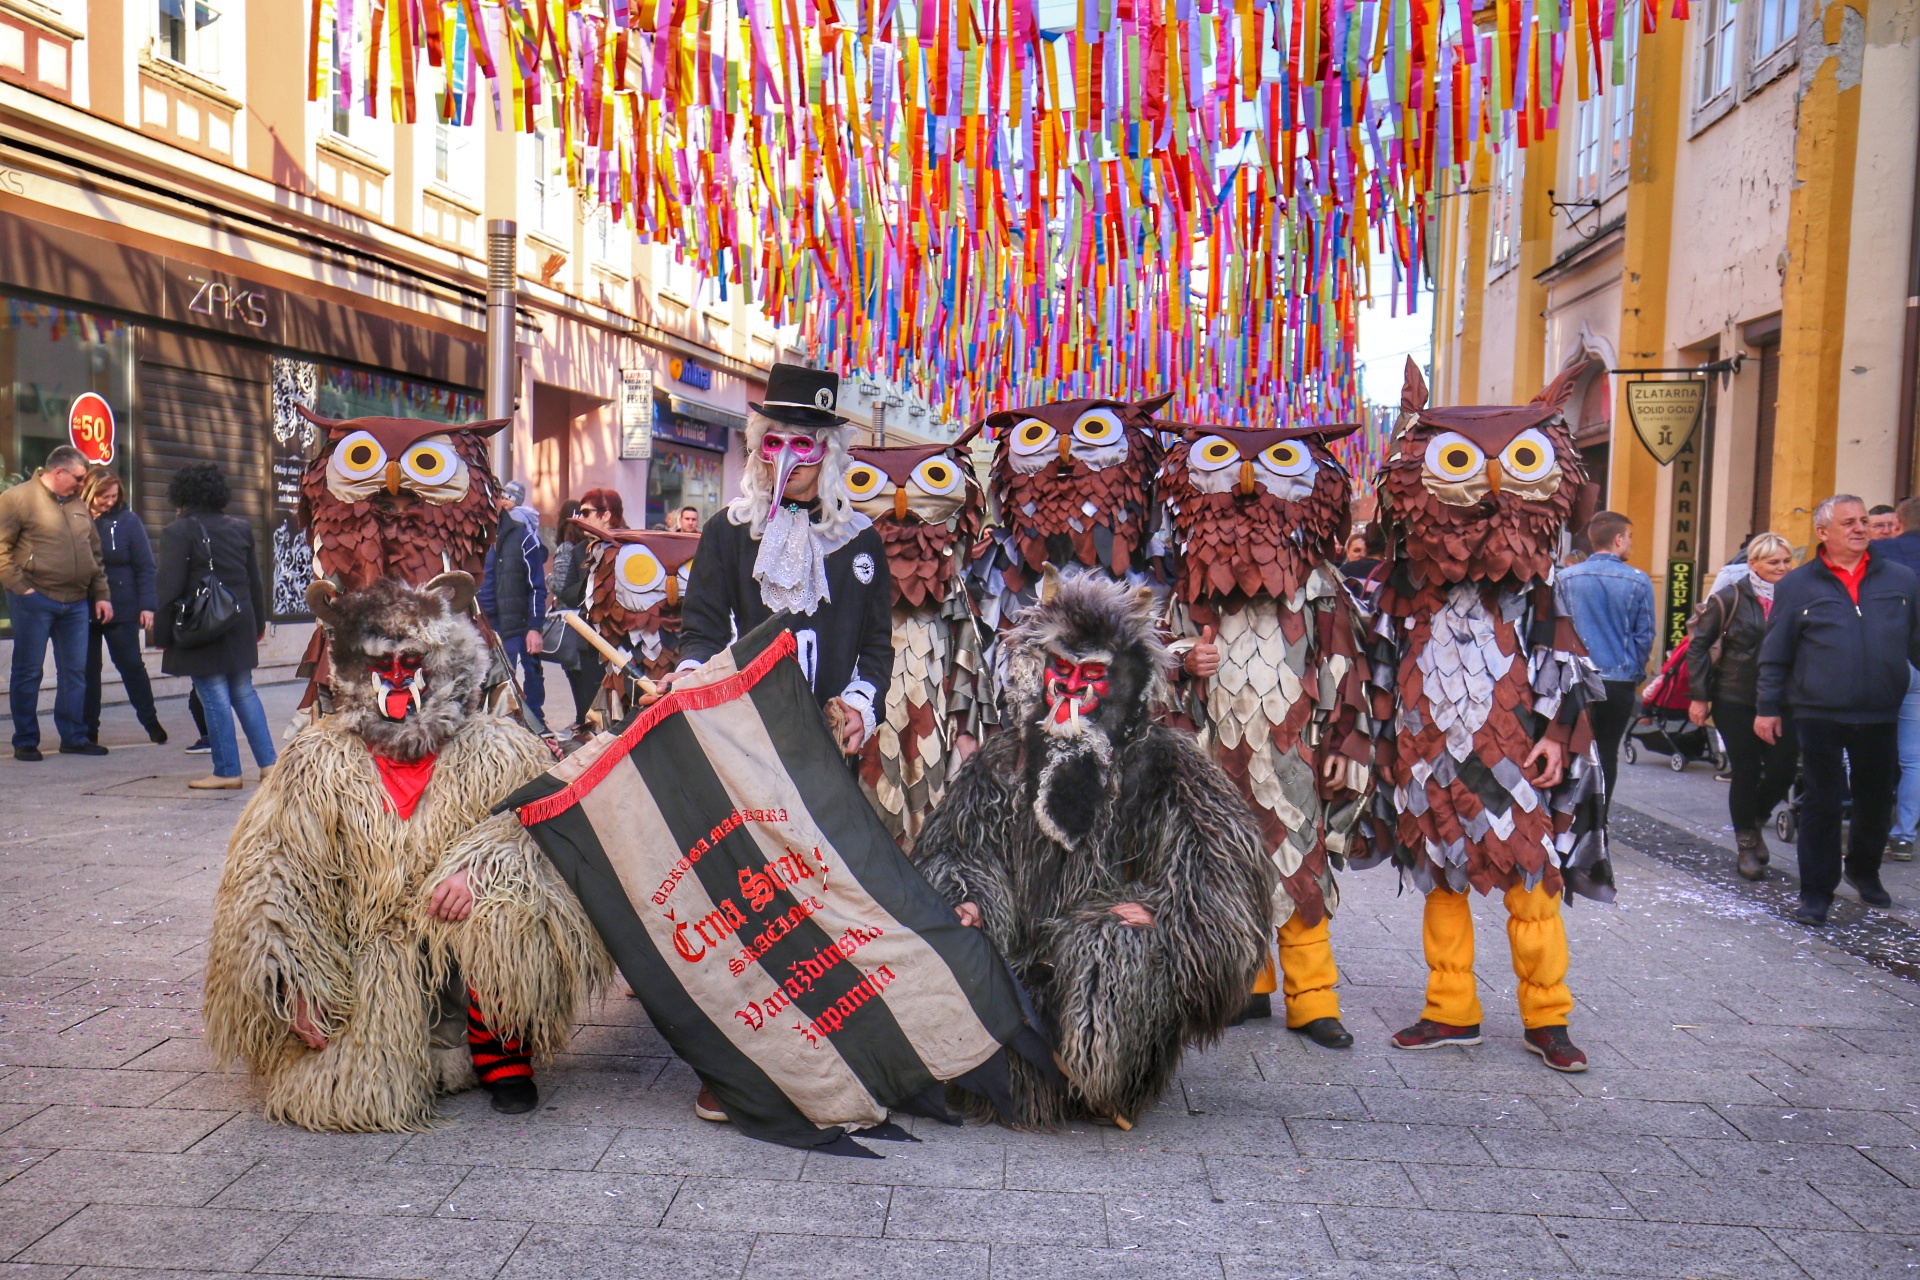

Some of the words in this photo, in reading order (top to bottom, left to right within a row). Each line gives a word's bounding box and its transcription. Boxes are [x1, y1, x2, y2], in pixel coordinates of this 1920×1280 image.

[188, 275, 267, 327] ZAKS
[1635, 389, 1697, 399] ZLATARNA
[1637, 406, 1665, 415] SOLID
[1667, 406, 1695, 414] GOLD
[81, 414, 106, 443] 50
[1673, 563, 1689, 607] OTKUP
[652, 837, 711, 905] UDRUGA
[710, 808, 788, 845] MAŠKARA
[663, 898, 748, 962] Črna
[728, 896, 824, 977] SRAČINEC
[734, 924, 884, 1031] Varaždinska
[792, 965, 896, 1050] županija
